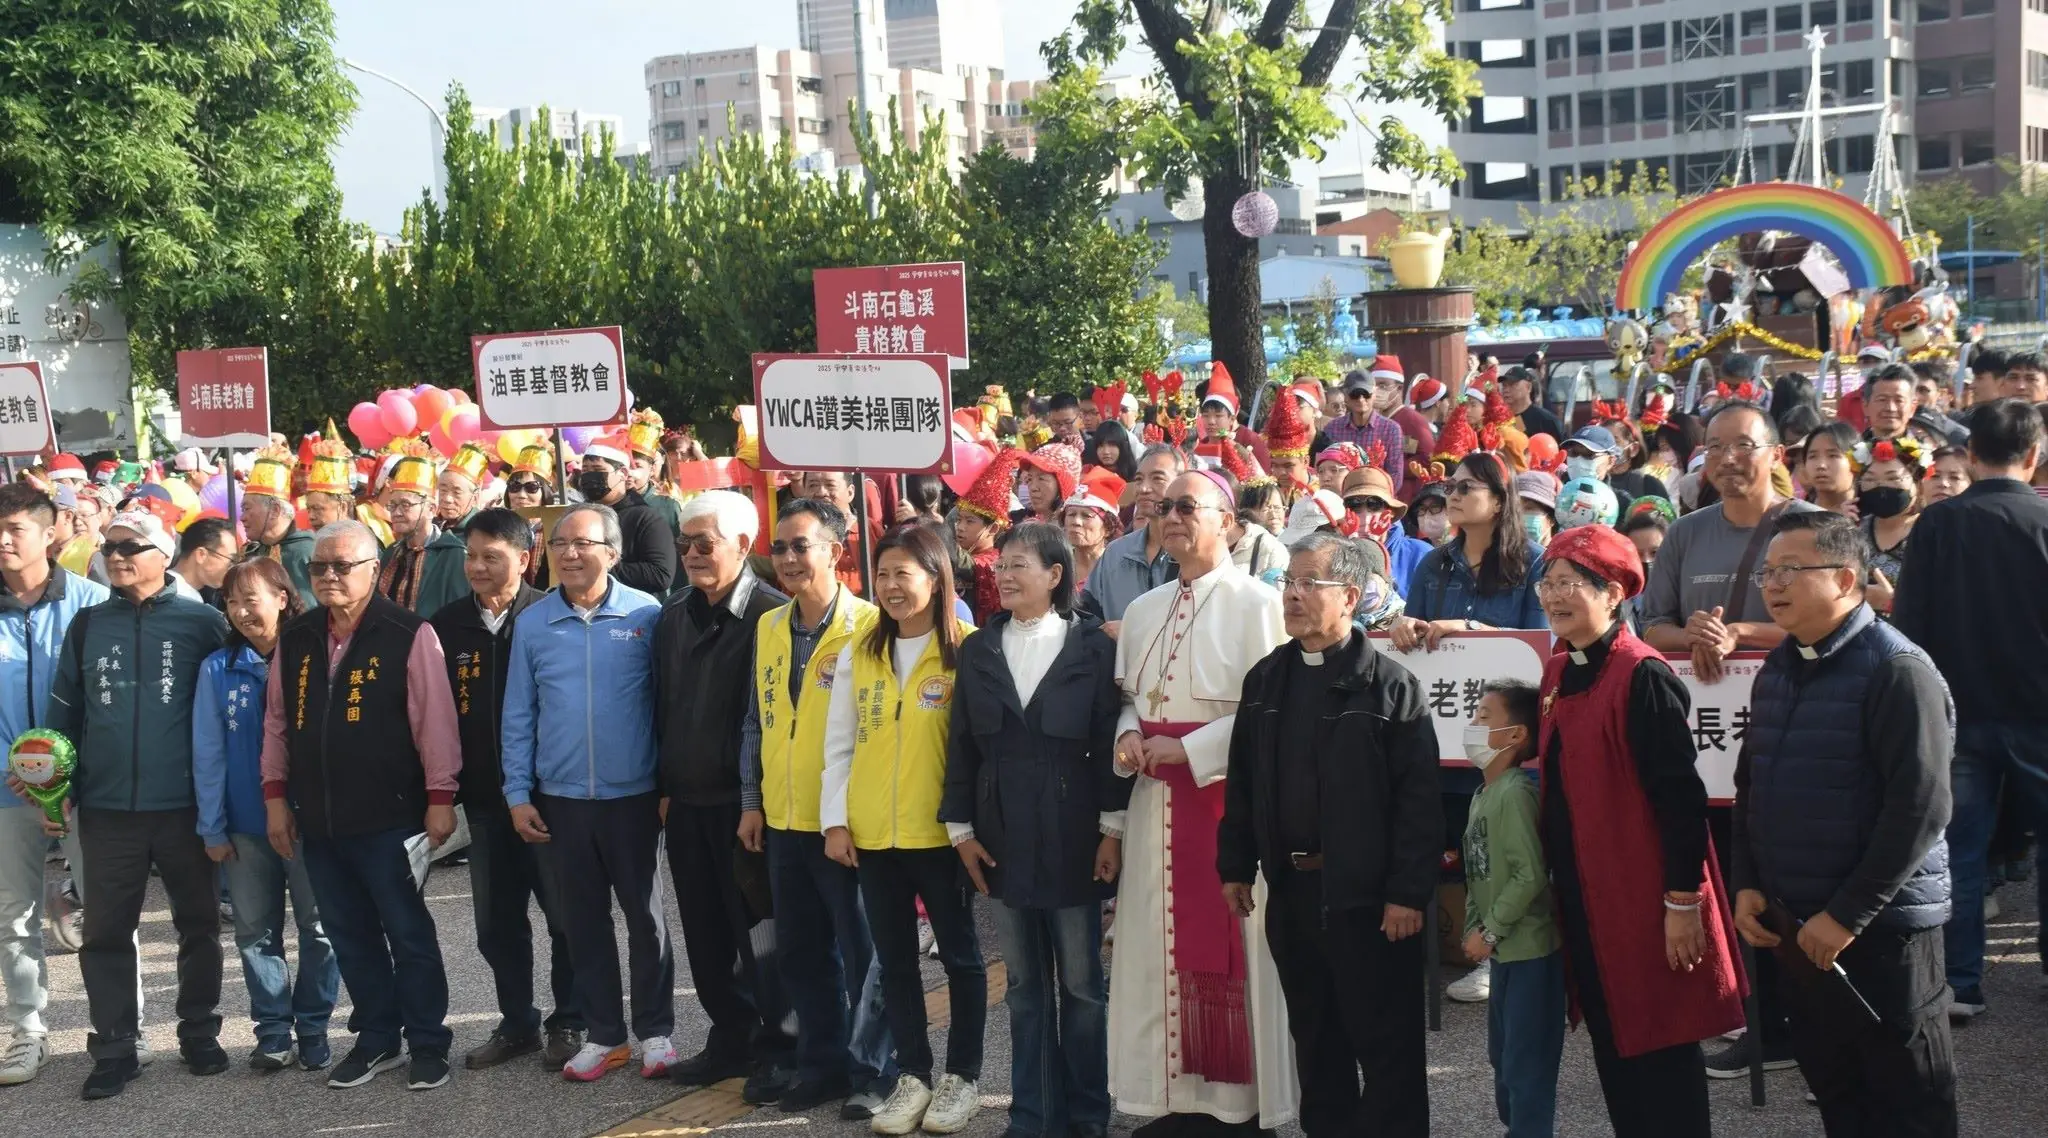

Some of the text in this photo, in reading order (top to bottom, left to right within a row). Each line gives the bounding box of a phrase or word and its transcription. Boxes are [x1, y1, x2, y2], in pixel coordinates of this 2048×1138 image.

[844, 288, 935, 320] 斗南石龜溪
[855, 324, 927, 354] 貴格教會
[190, 382, 255, 411] 斗南長老教會
[489, 362, 610, 398] 油車基督教會
[764, 395, 943, 433] YWCA讚美操團隊
[347, 670, 364, 722] 張再固
